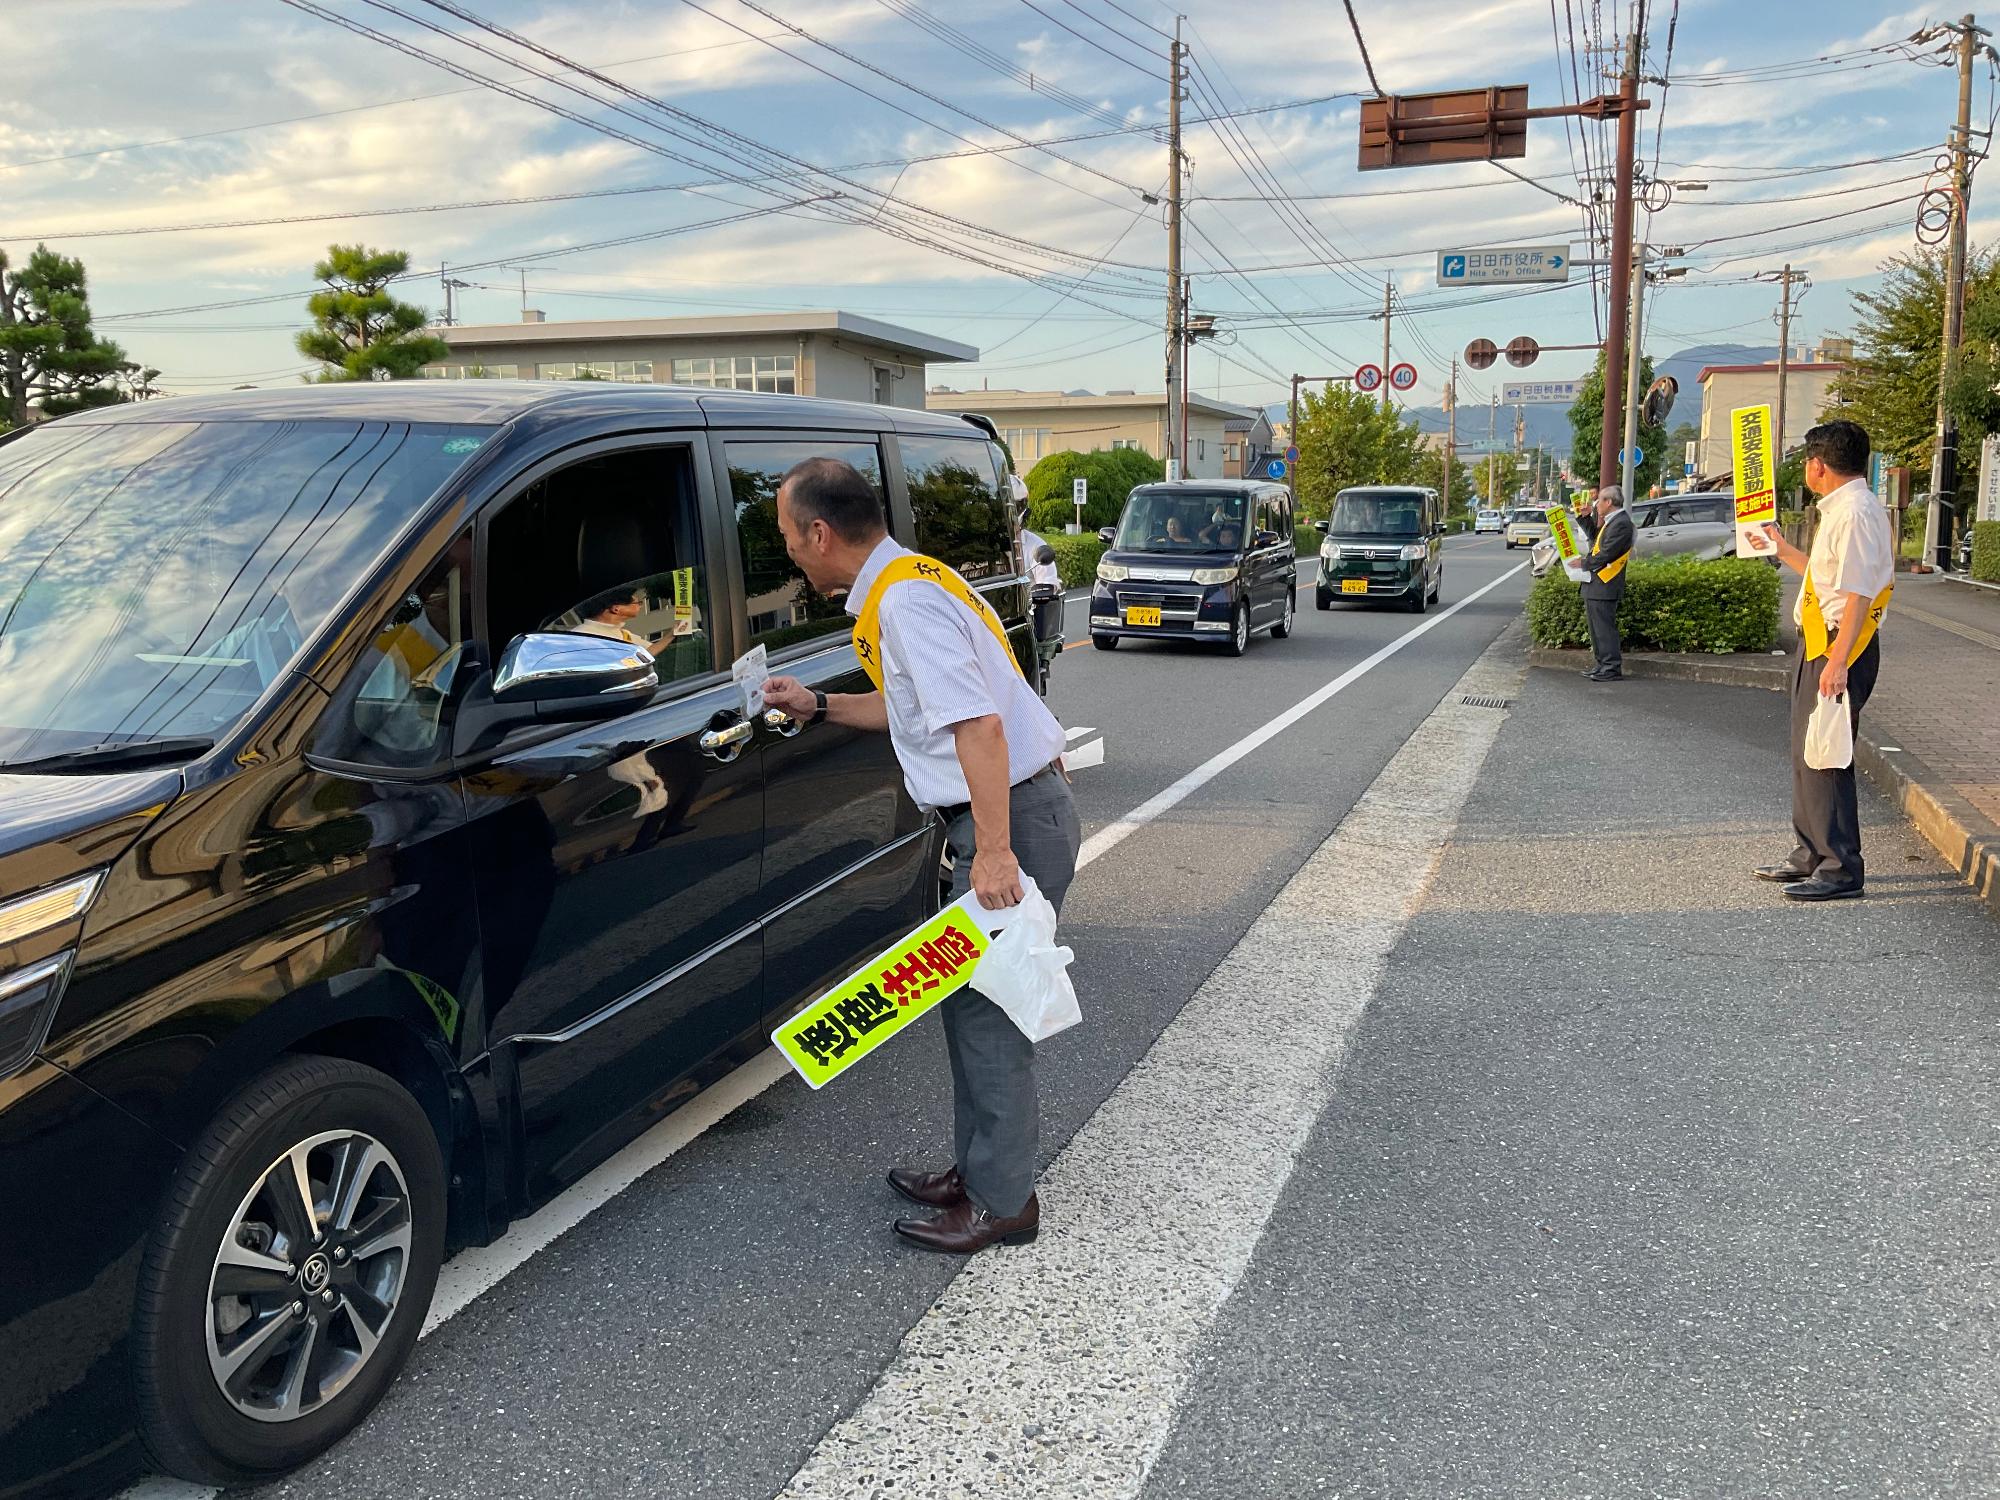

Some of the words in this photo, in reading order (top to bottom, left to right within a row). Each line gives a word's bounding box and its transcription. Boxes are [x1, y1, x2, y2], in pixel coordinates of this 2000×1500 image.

[1469, 252, 1543, 267] 日田市役所
[1492, 269, 1509, 277] City
[1516, 267, 1541, 275] Office
[1396, 371, 1410, 383] 40
[1740, 410, 1765, 495] 交通安全運動
[1736, 492, 1773, 515] 実施中
[793, 925, 981, 1066] 速度注意
